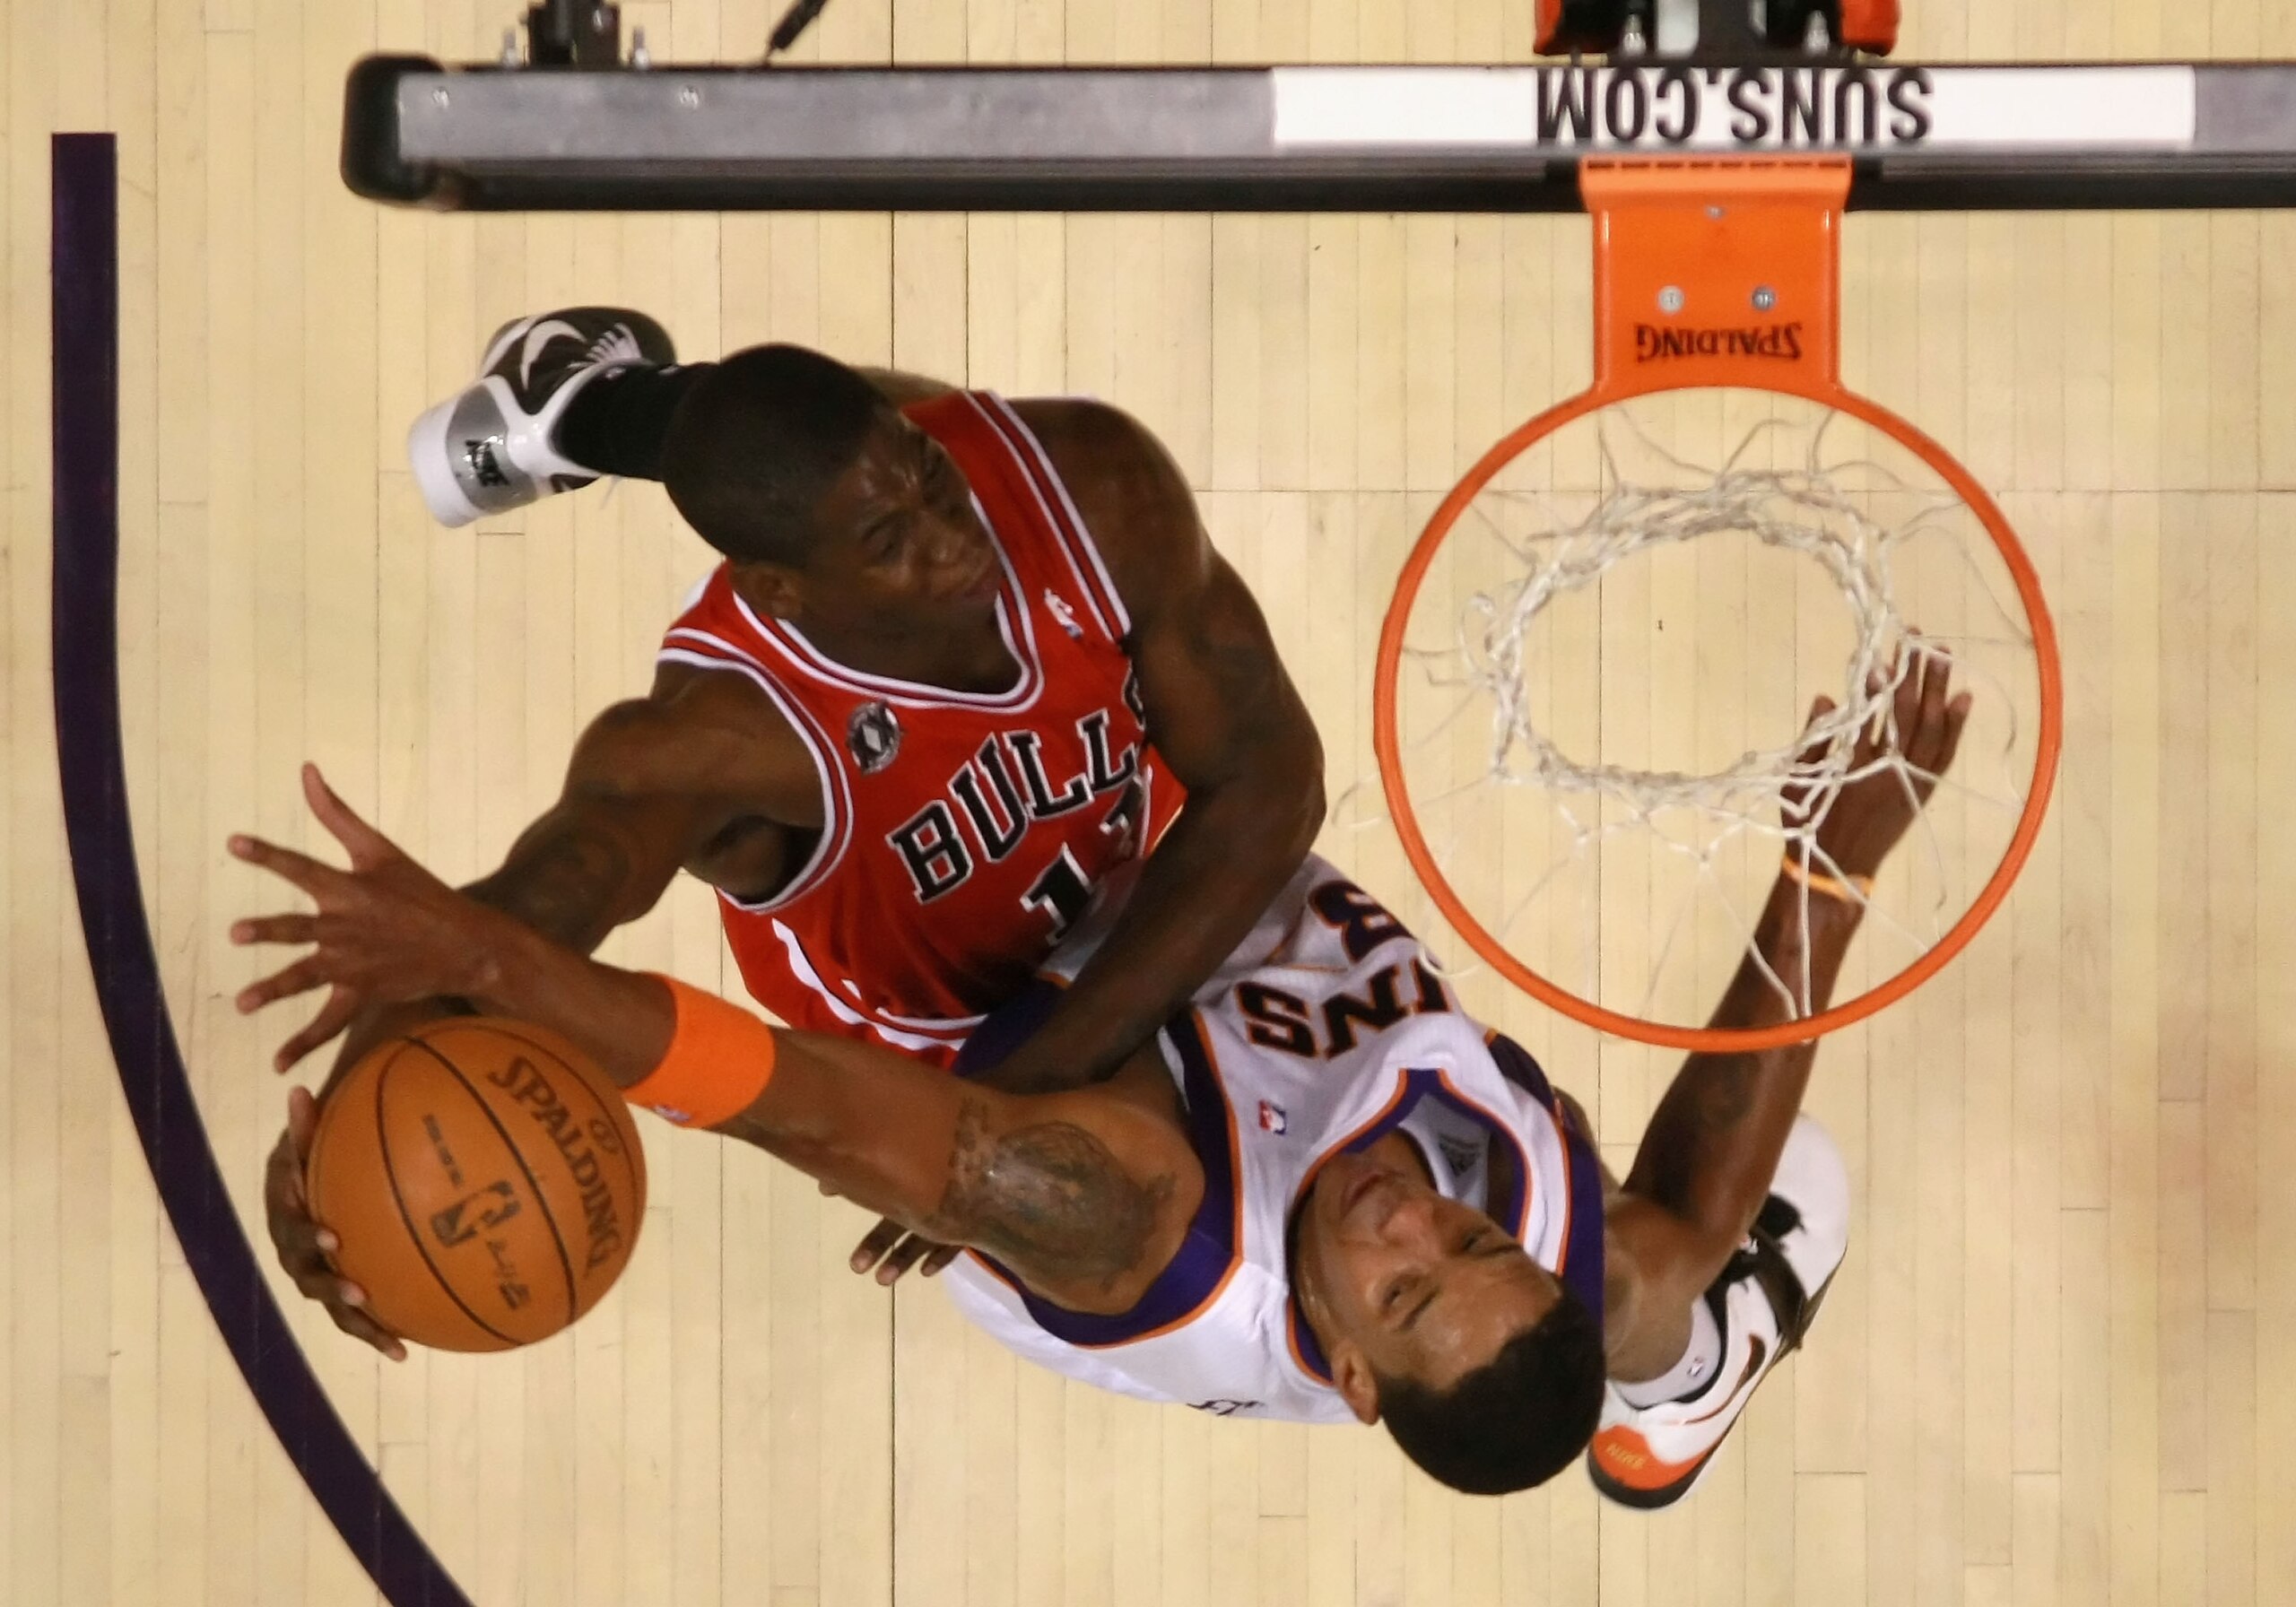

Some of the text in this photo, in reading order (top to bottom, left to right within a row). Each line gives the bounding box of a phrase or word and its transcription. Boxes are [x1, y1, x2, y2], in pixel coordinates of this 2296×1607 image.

[1536, 65, 1934, 142] SUNS.COM
[1634, 322, 1803, 362] SPALDING
[487, 1055, 622, 1273] SPALDING
